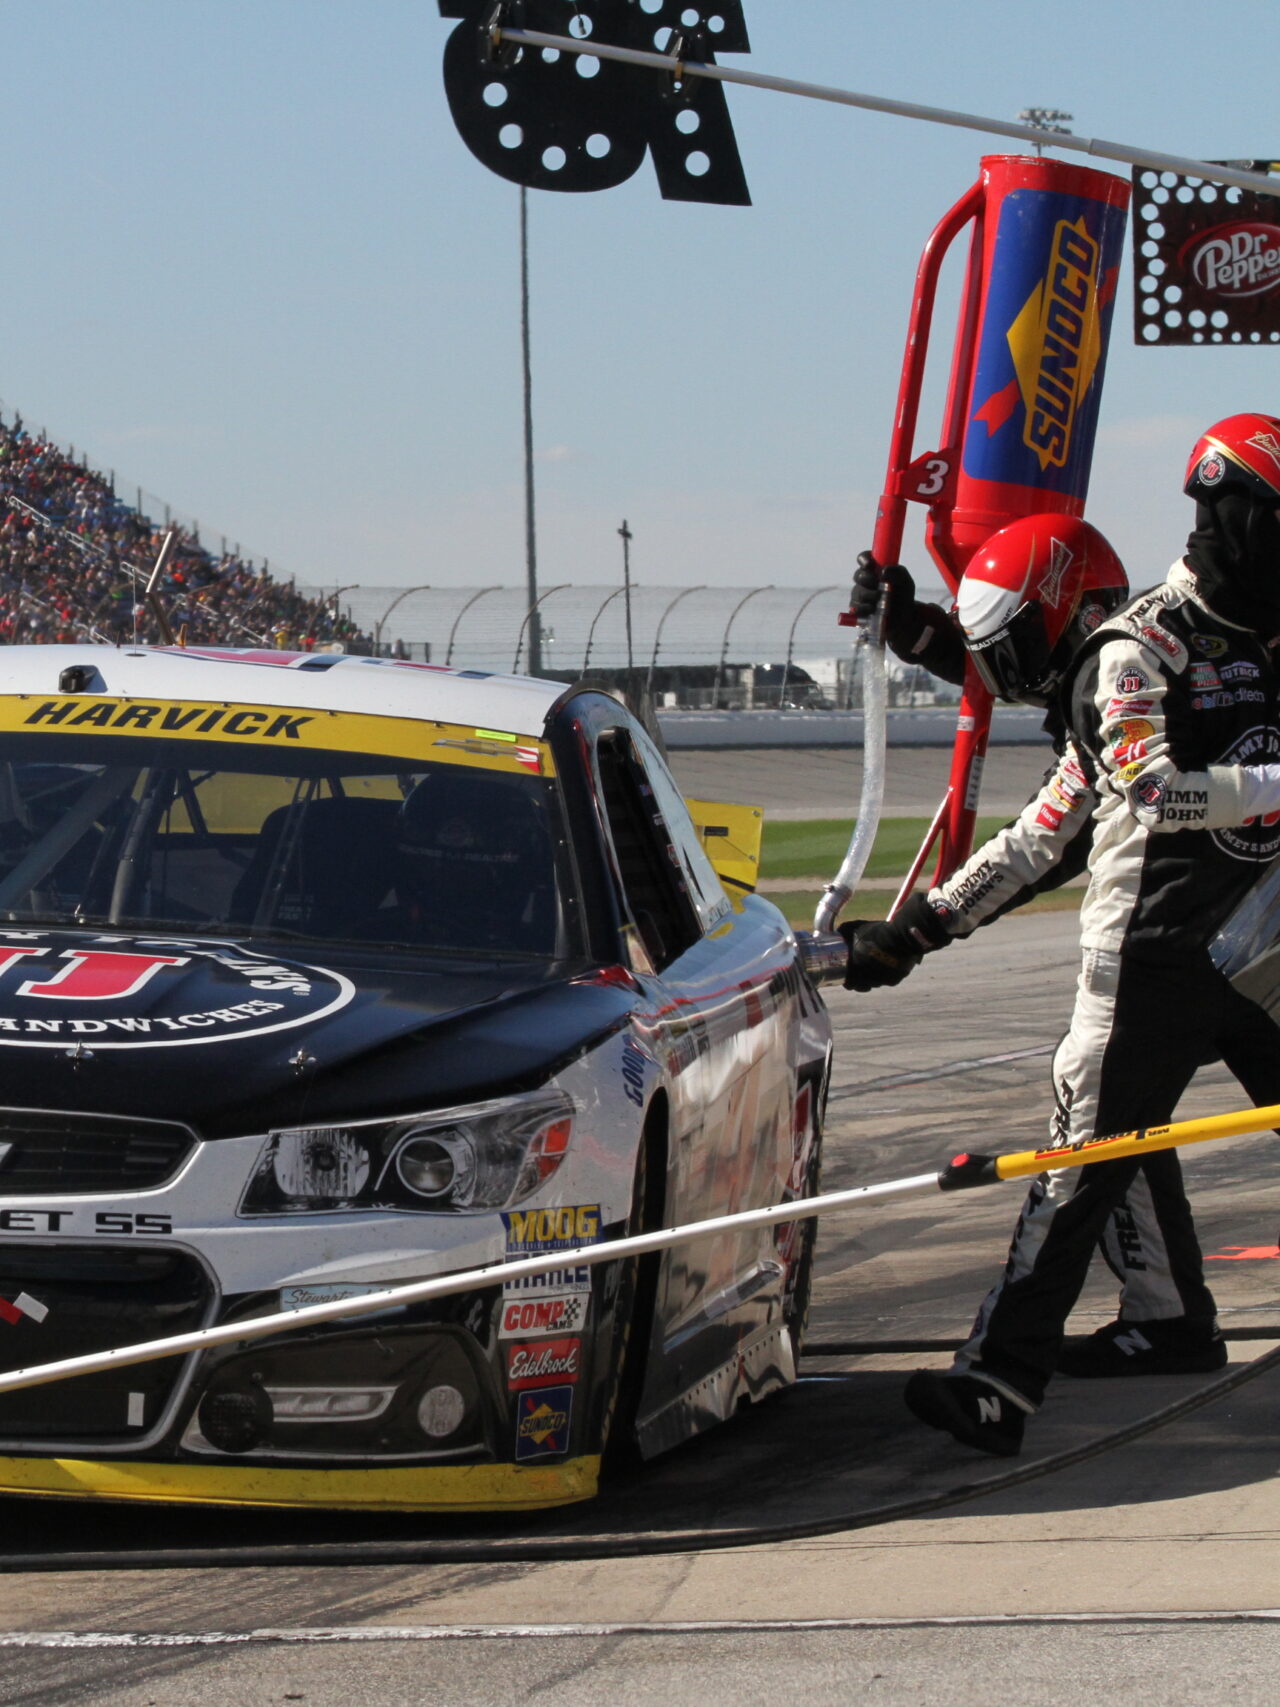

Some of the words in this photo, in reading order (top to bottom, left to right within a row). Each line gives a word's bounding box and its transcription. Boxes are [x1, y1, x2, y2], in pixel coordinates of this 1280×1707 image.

[1230, 231, 1268, 262] Dr
[1193, 239, 1280, 290] Peppe
[1031, 225, 1096, 463] SUNOCO
[916, 459, 950, 496] 3
[23, 702, 315, 739] HARVICK
[95, 1212, 174, 1235] SS
[507, 1206, 599, 1243] MOOG
[504, 1300, 565, 1331] COMP
[546, 1319, 574, 1331] CAMS
[1113, 1328, 1152, 1356] N
[509, 1347, 578, 1379] Edelbrock
[520, 1412, 566, 1435] SUNOCO
[978, 1396, 1002, 1424] N
